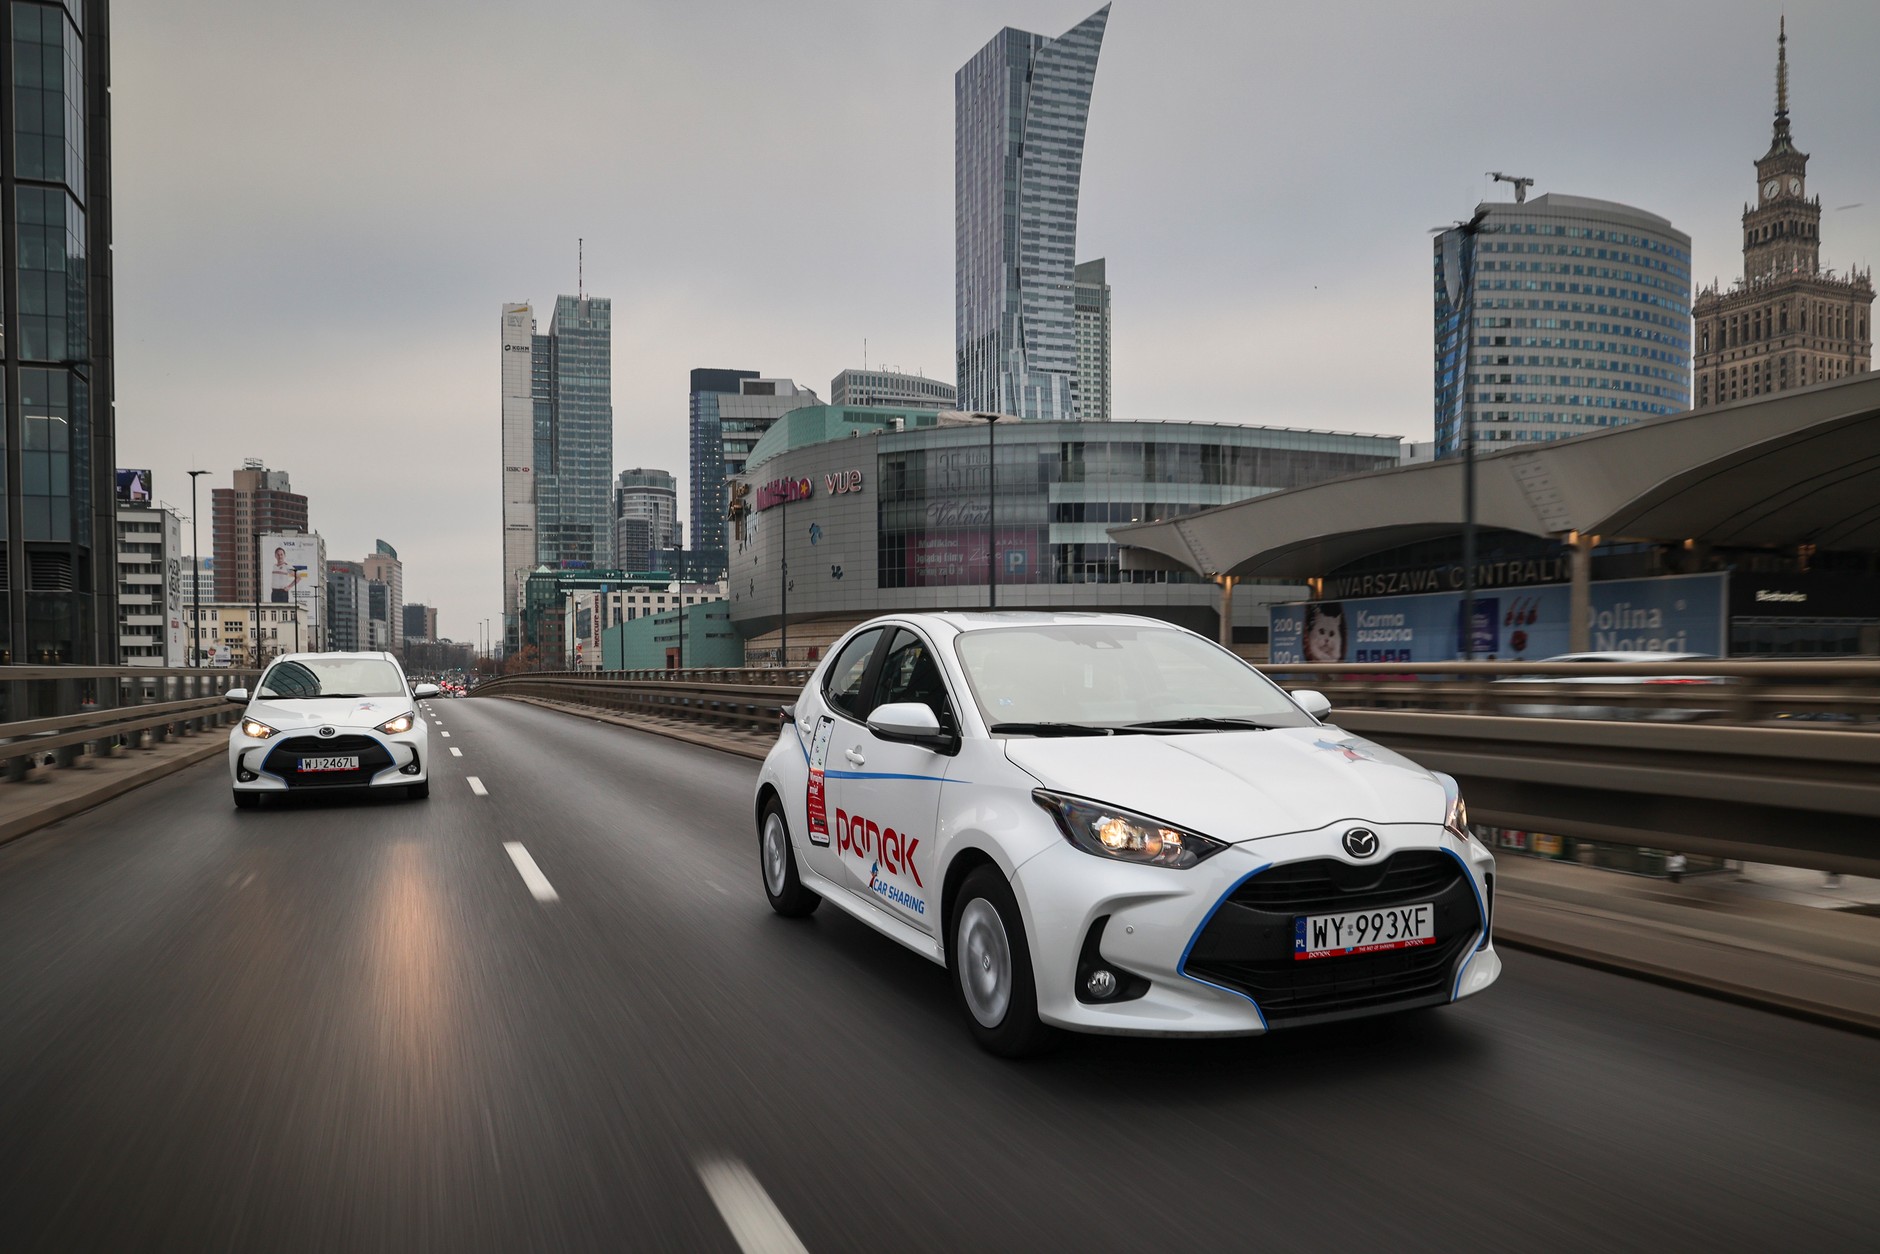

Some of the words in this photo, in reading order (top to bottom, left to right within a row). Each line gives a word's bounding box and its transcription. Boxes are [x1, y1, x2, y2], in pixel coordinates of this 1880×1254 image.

[507, 315, 525, 327] EY
[1009, 553, 1023, 571] P
[1337, 569, 1440, 596] WARSZAWA
[1450, 557, 1572, 589] CNTRALN
[1273, 618, 1293, 632] 200
[1295, 621, 1302, 635] g
[1357, 610, 1405, 628] Karma
[1356, 628, 1413, 643] suszona
[1595, 630, 1687, 652] Noteci
[1274, 651, 1291, 664] 100
[304, 758, 318, 769] WJ
[323, 757, 357, 768] 2467L
[873, 878, 888, 894] CAR
[888, 886, 925, 914] SHARING
[1313, 916, 1345, 949] WY
[1356, 907, 1428, 944] 993XF
[1295, 939, 1306, 948] PL
